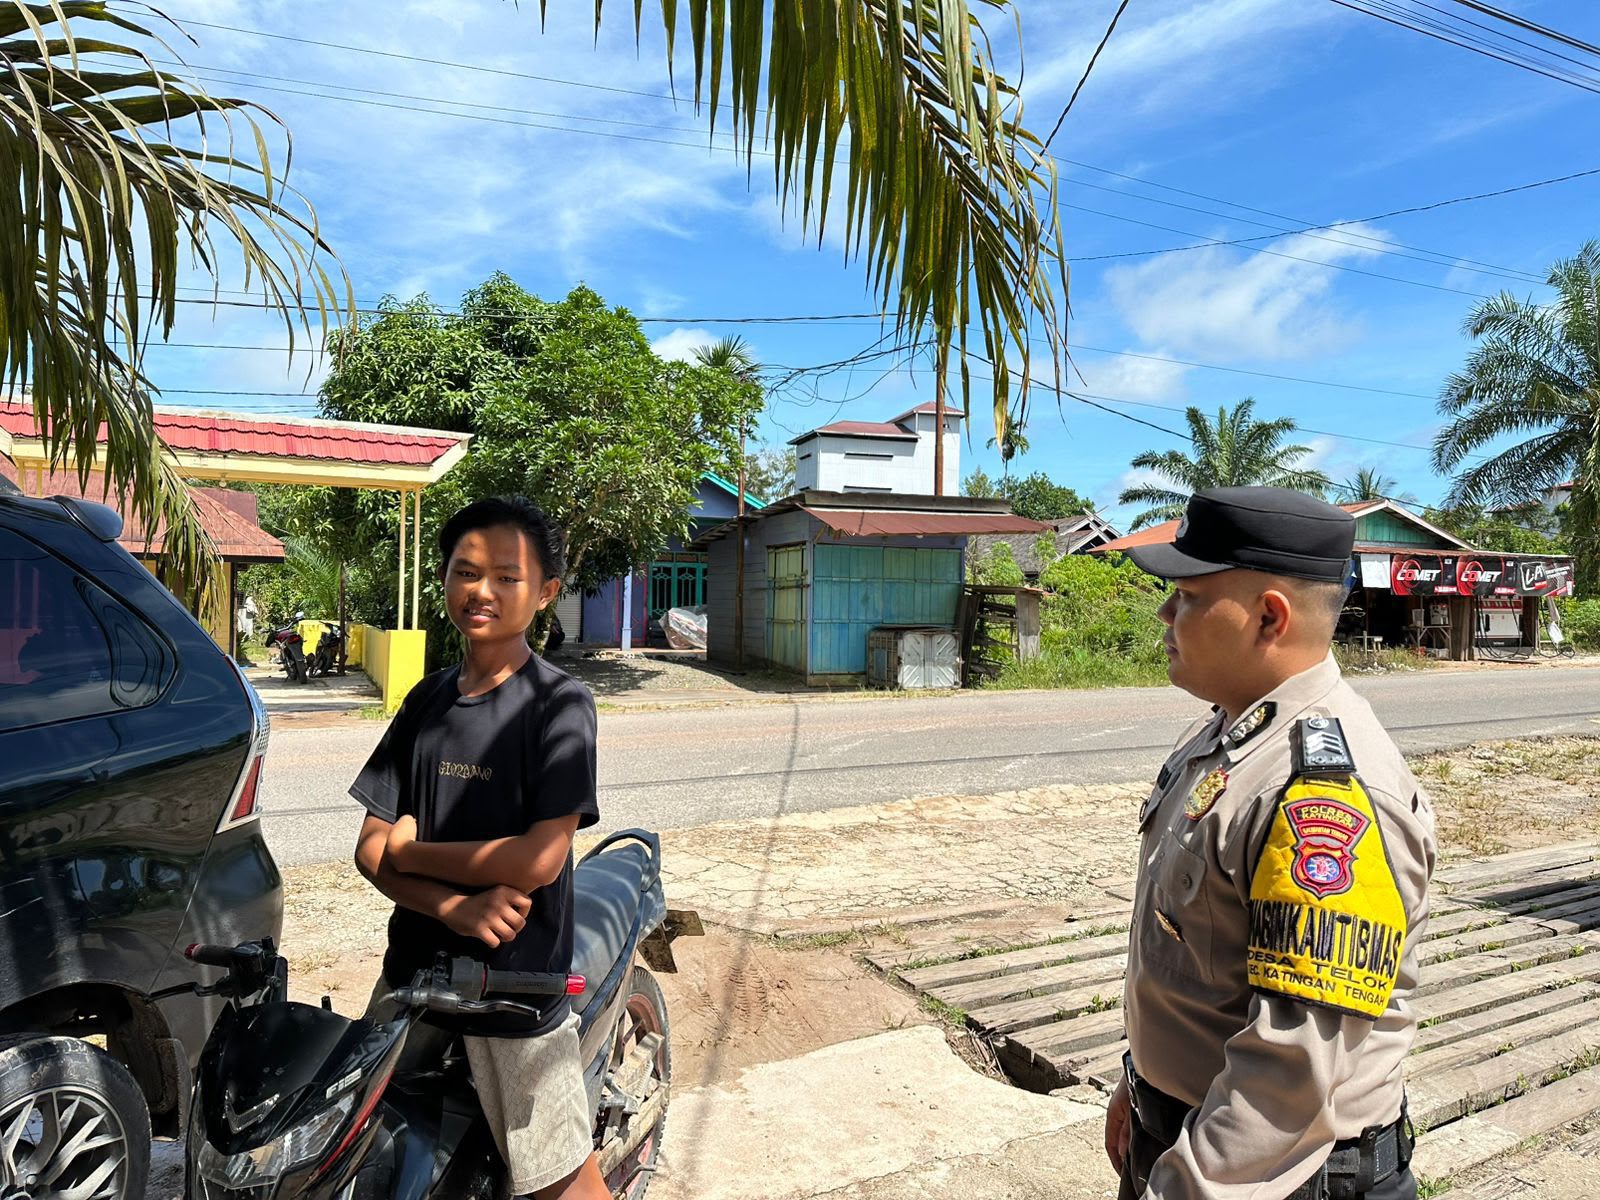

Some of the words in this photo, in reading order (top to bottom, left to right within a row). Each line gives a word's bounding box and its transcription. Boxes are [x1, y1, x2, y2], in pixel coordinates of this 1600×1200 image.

[1396, 569, 1441, 582] COMET
[1460, 570, 1503, 583] COMET
[1301, 805, 1354, 823] POLRES
[1248, 949, 1296, 969] DESA
[1311, 961, 1388, 991] TELOK
[1263, 966, 1337, 993] KATINGAN
